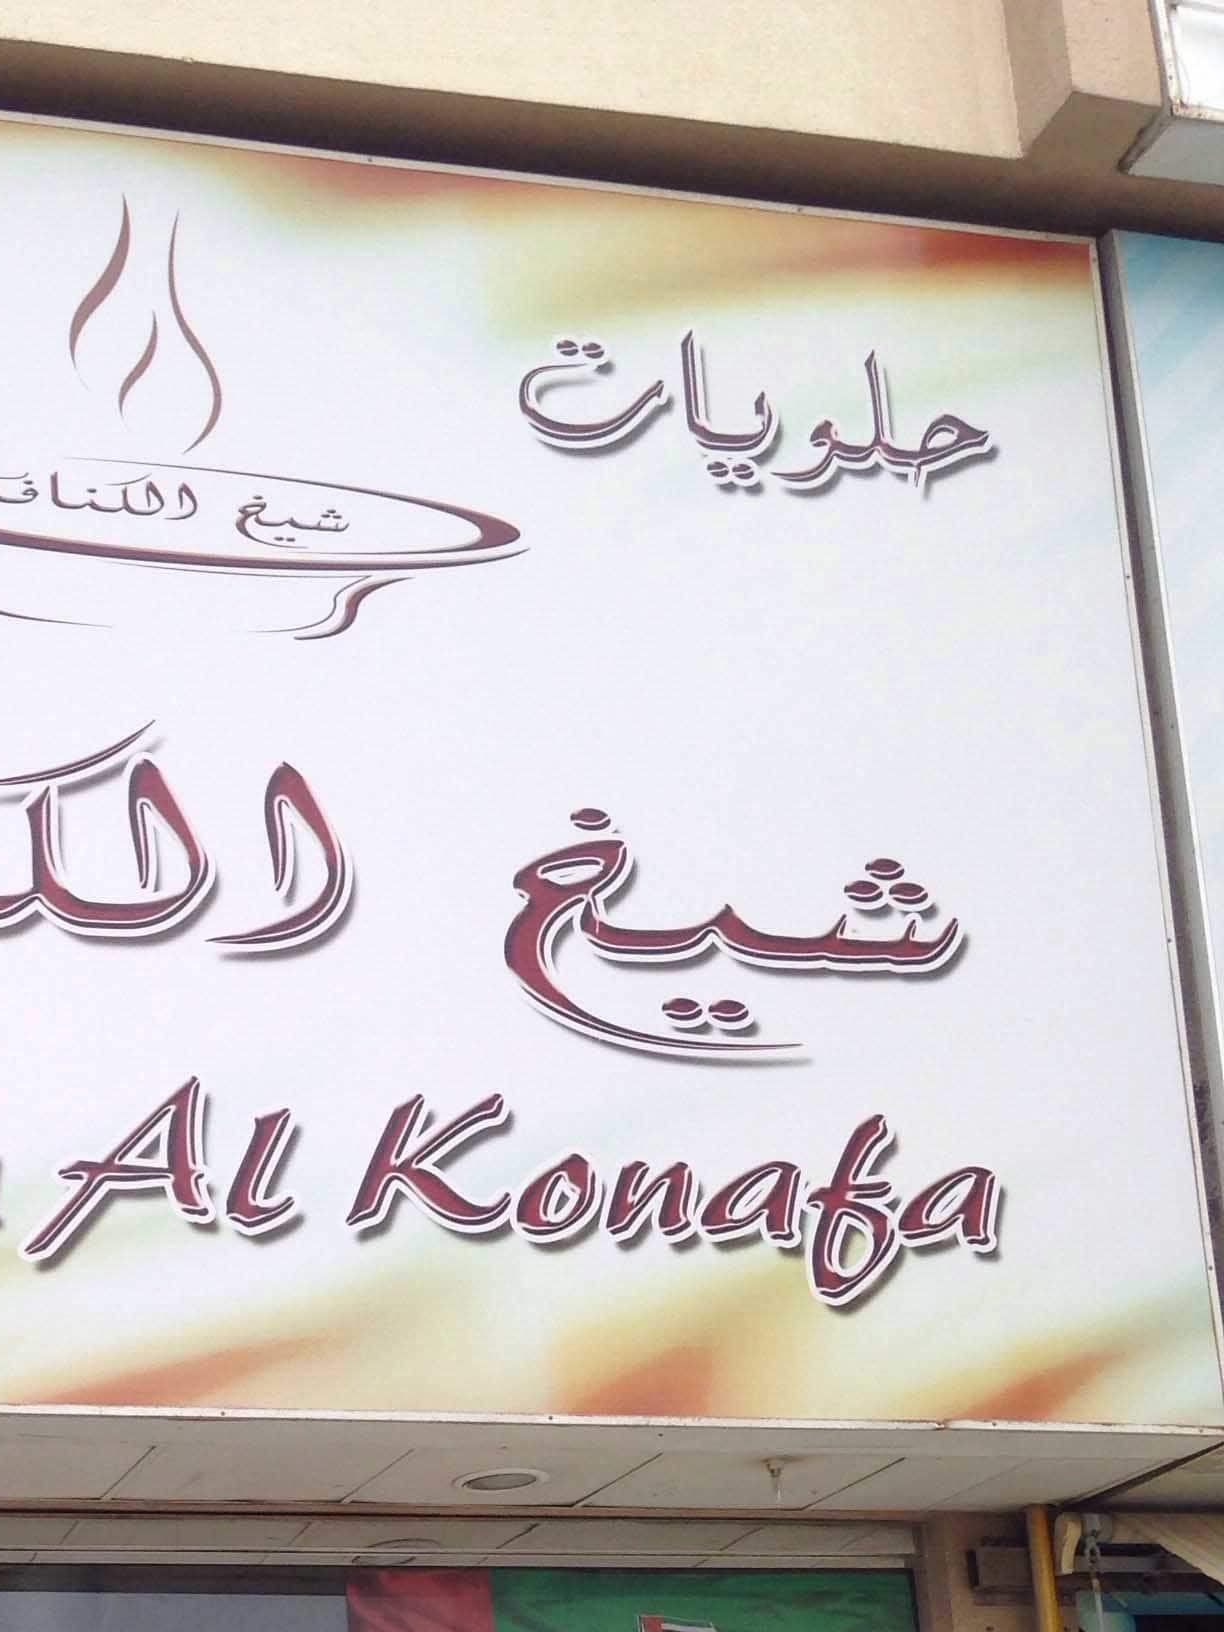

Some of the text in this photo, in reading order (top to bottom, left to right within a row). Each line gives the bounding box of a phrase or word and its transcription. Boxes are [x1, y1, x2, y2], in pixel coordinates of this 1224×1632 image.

[518, 329, 992, 490] حلويات
[234, 493, 352, 549] شيخ
[503, 806, 964, 1054] شيخ
[22, 1073, 298, 1260] Al
[345, 1090, 1002, 1303] Konafa
